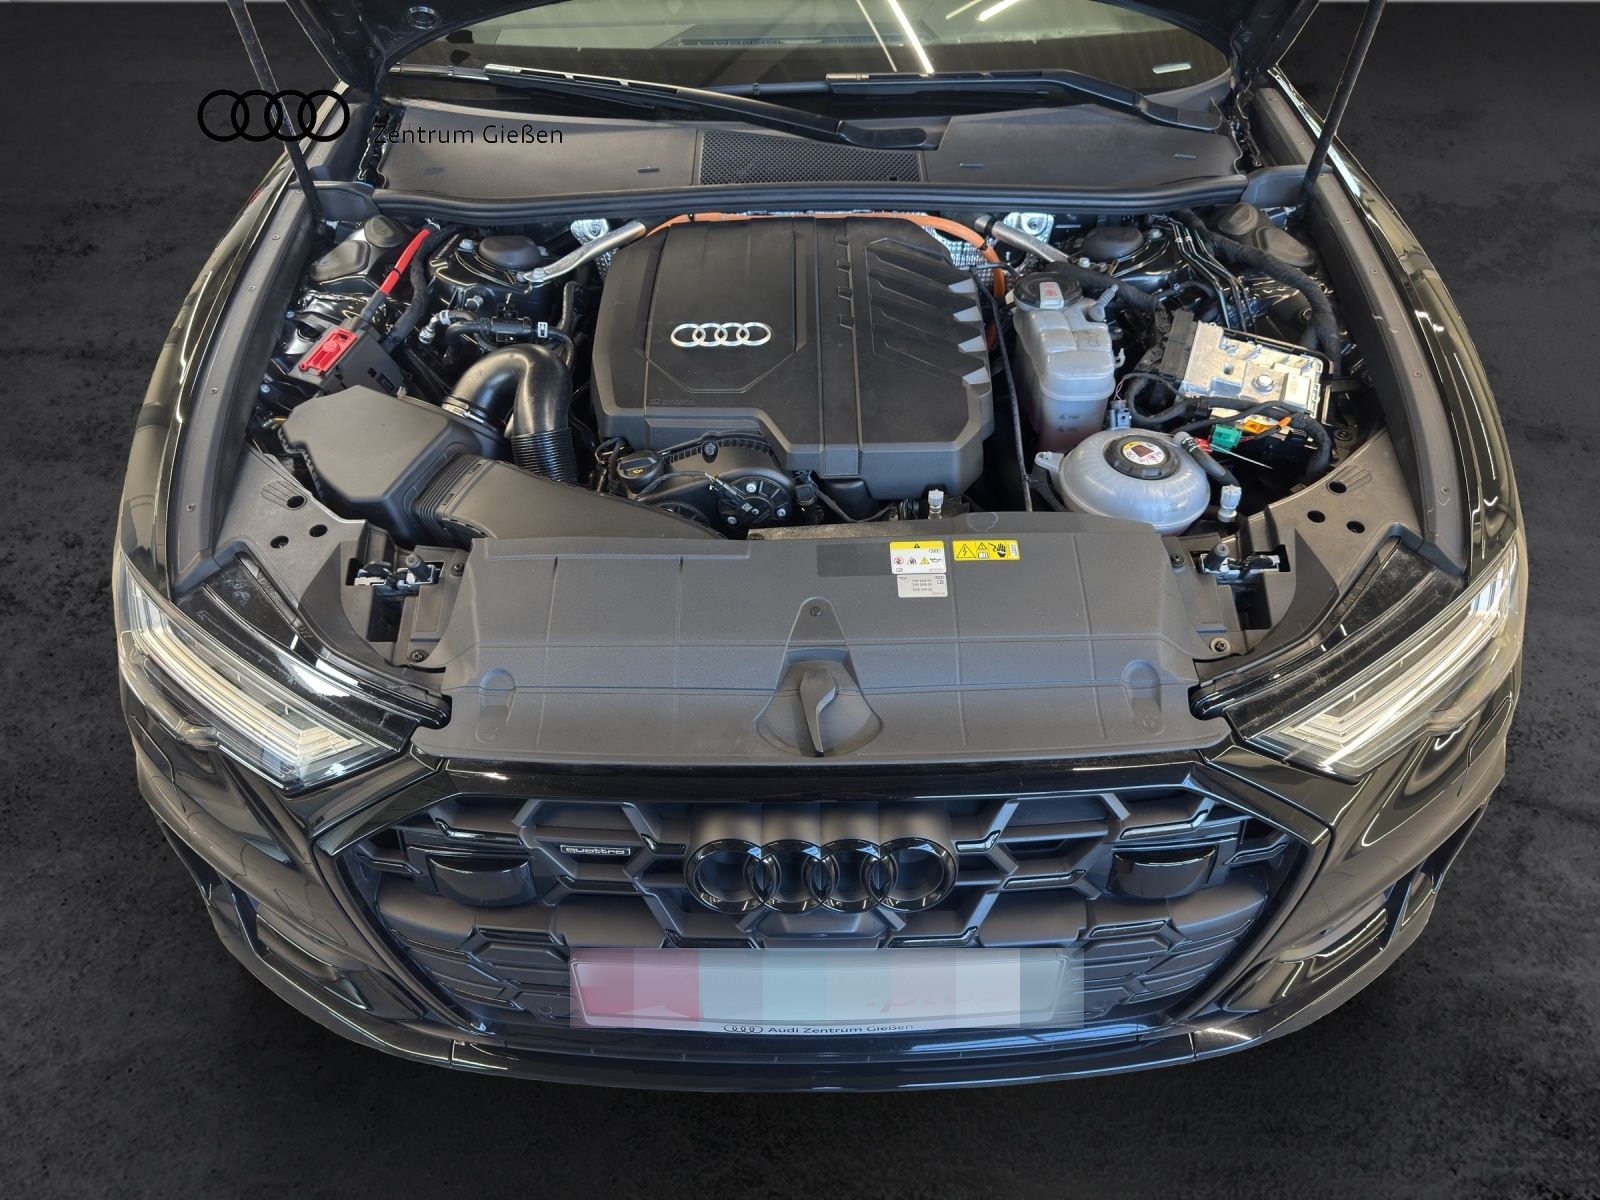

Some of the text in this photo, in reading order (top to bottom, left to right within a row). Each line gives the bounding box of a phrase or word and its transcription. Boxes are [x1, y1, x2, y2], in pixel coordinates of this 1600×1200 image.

[566, 847, 625, 855] quattro
[768, 1026, 799, 1034] Audi
[866, 1025, 914, 1033] Gießen
